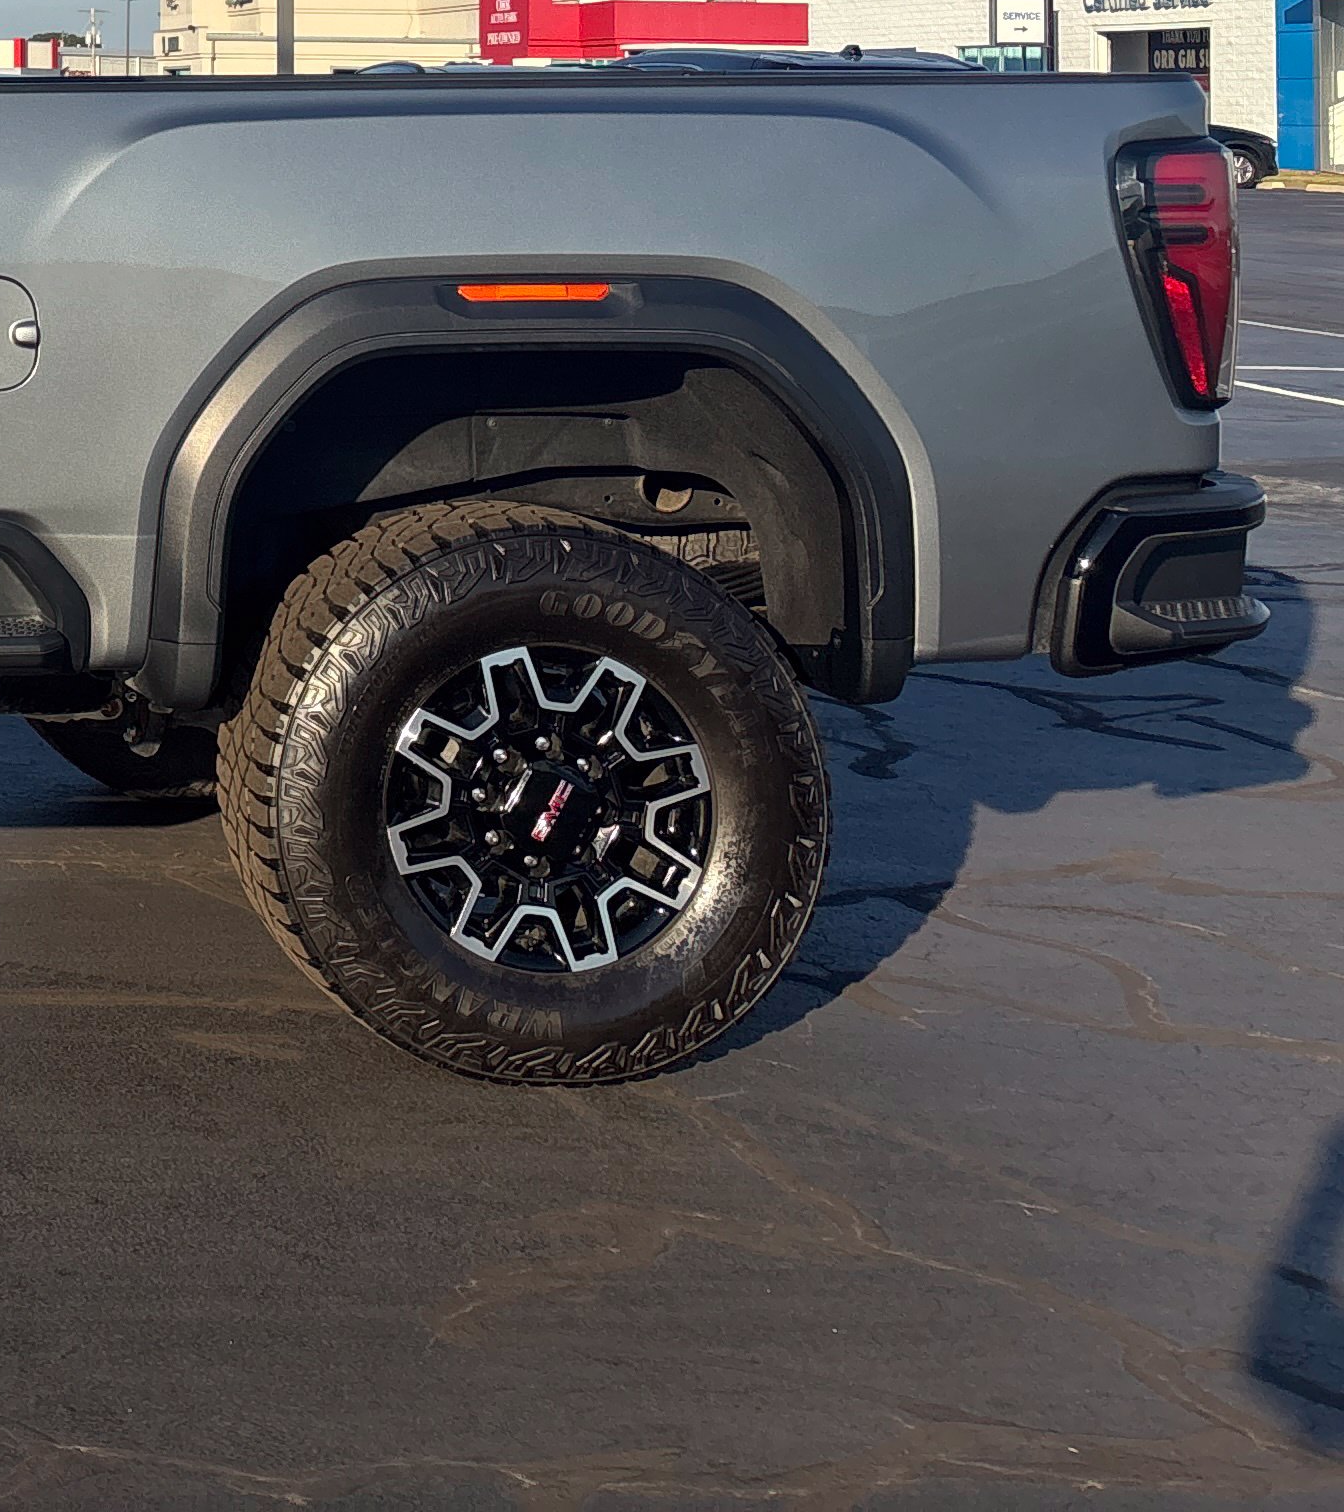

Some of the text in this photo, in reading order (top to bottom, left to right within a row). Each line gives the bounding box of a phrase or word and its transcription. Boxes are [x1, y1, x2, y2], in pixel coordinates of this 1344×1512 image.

[1002, 12, 1041, 20] SERVICE
[1153, 49, 1176, 69] ORR
[1178, 49, 1197, 68] GM
